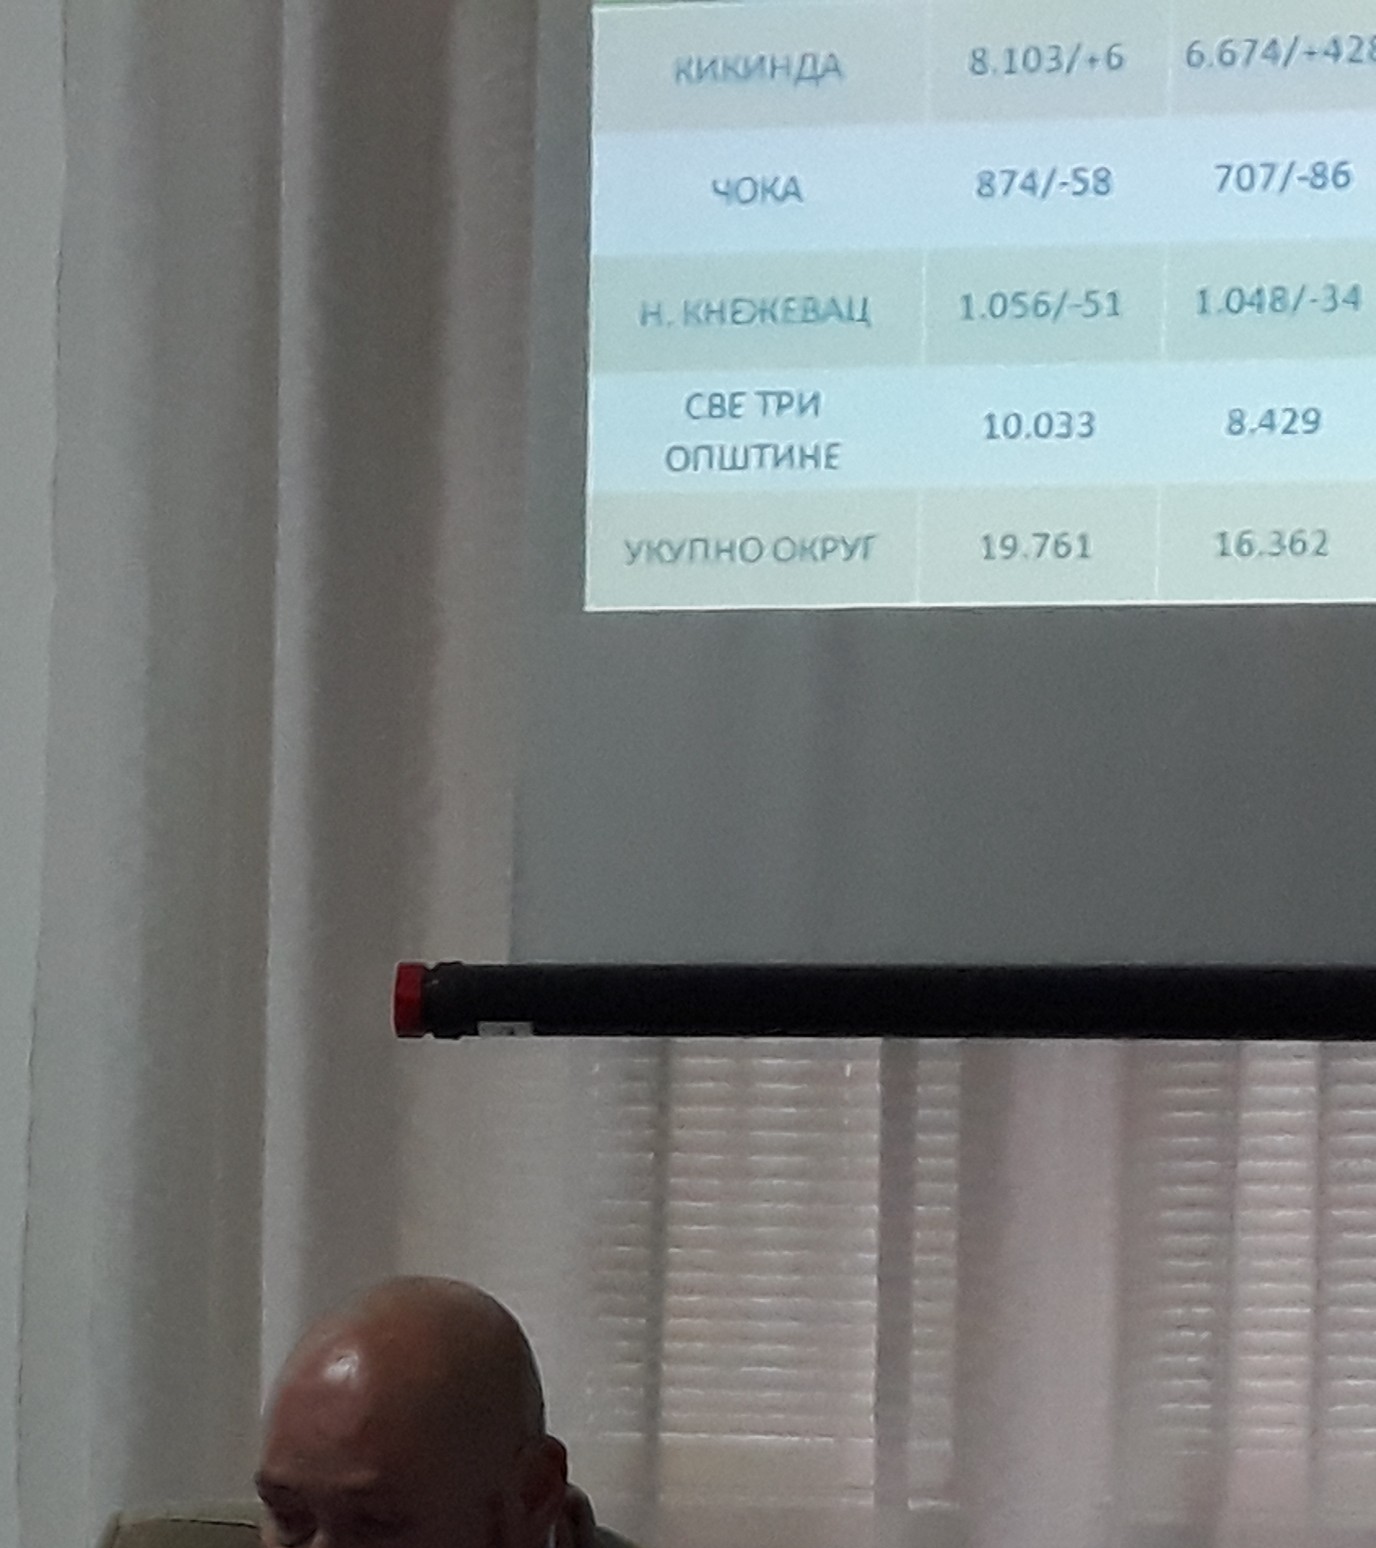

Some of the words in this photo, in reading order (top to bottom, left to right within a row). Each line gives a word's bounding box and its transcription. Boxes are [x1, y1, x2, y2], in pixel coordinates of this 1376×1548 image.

[672, 50, 845, 86] КИКИНДА
[968, 43, 1125, 78] 8.103/+6
[712, 175, 803, 205] ЧОКА
[976, 167, 1113, 200] 874/-58
[1214, 160, 1353, 195] 707/-86
[638, 300, 674, 329] Н.
[683, 295, 872, 328] КНЕЖЕВАЦ
[960, 289, 1122, 323] 1.056/-51
[1196, 285, 1362, 318] 1.048/-34
[685, 392, 745, 421] СВЕ
[755, 391, 822, 418] ТРИ
[1226, 407, 1323, 437] 8.429
[984, 412, 1096, 442] 10.033
[664, 444, 842, 473] ОПШТИНЕ
[624, 537, 764, 566] УКУПНО
[772, 534, 878, 565] ОКРУГ
[981, 532, 1091, 561] 19.761
[1216, 529, 1330, 559] 16.362
